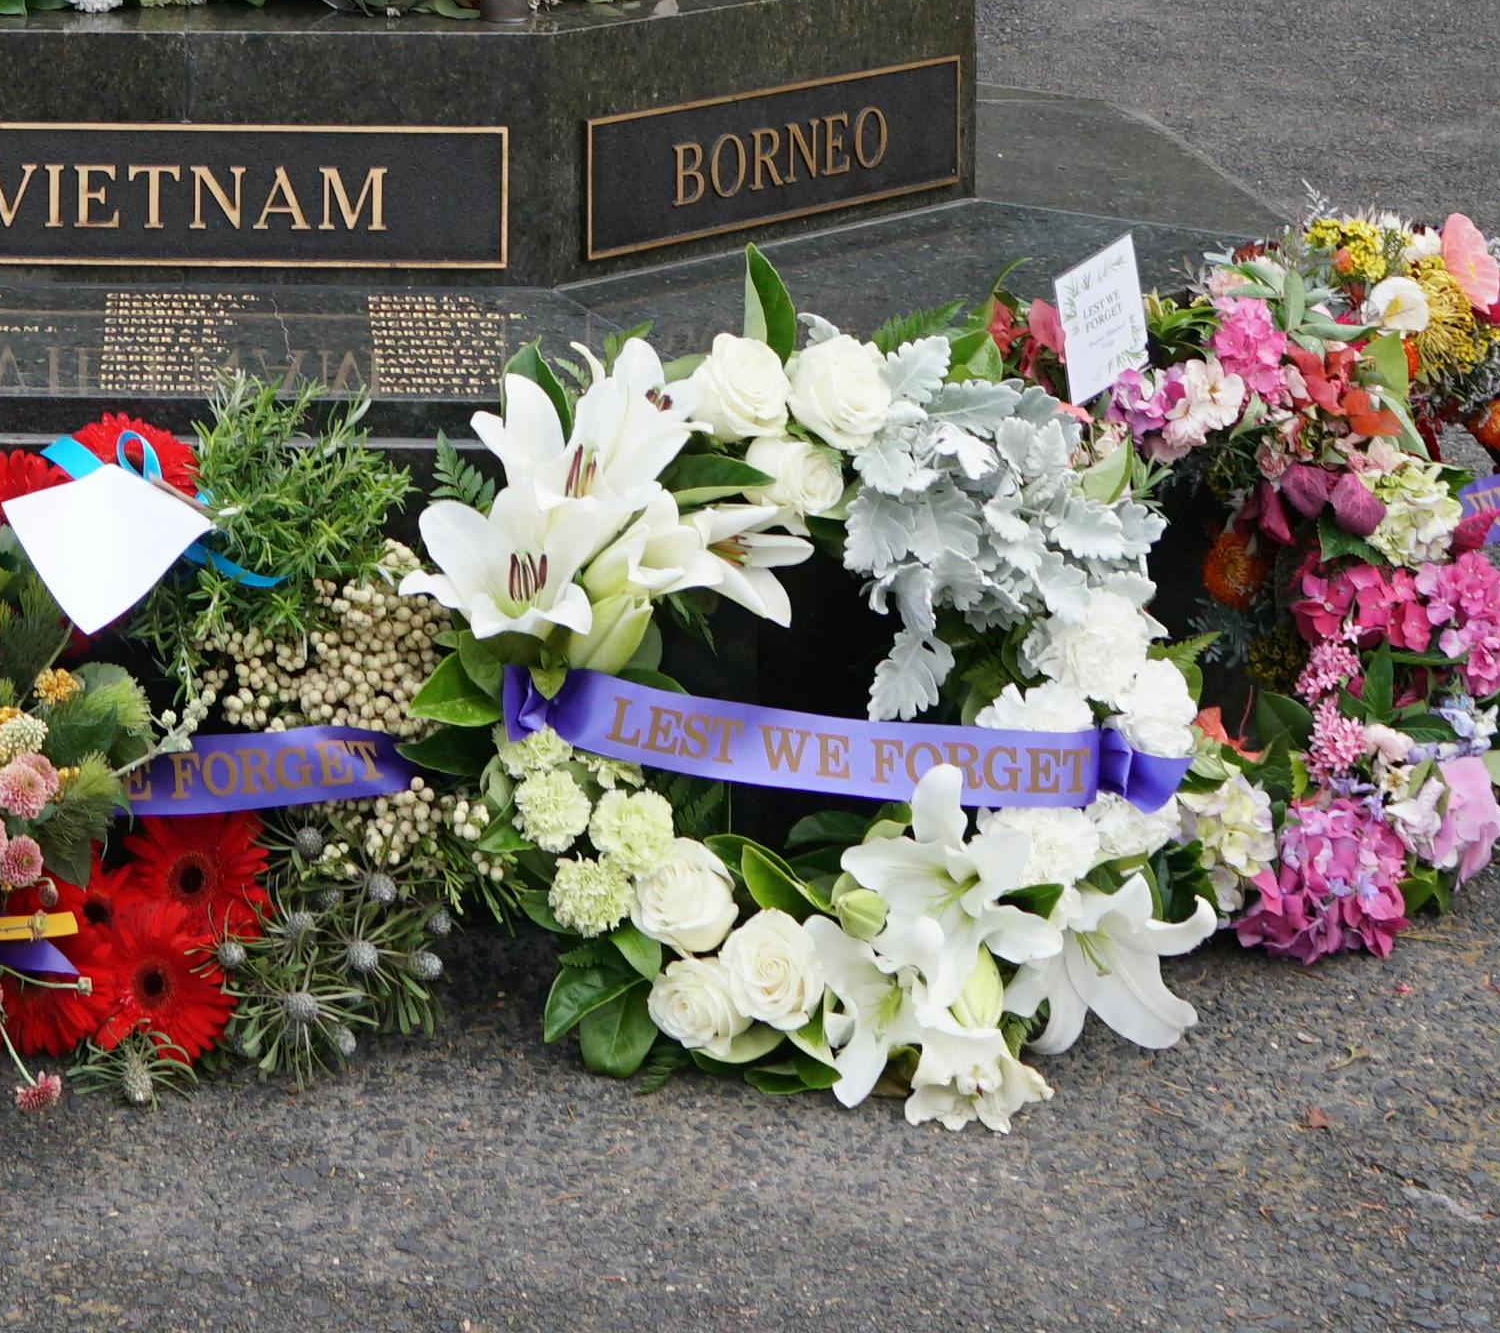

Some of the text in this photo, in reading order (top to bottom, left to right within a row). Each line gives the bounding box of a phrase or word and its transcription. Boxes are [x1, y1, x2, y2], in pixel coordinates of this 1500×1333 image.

[670, 103, 890, 209] BORNEO
[1082, 289, 1121, 321] LEST WE
[1085, 303, 1125, 333] FORGET
[170, 739, 385, 801] FORGET
[605, 695, 1092, 795] LEST WE FORGET
